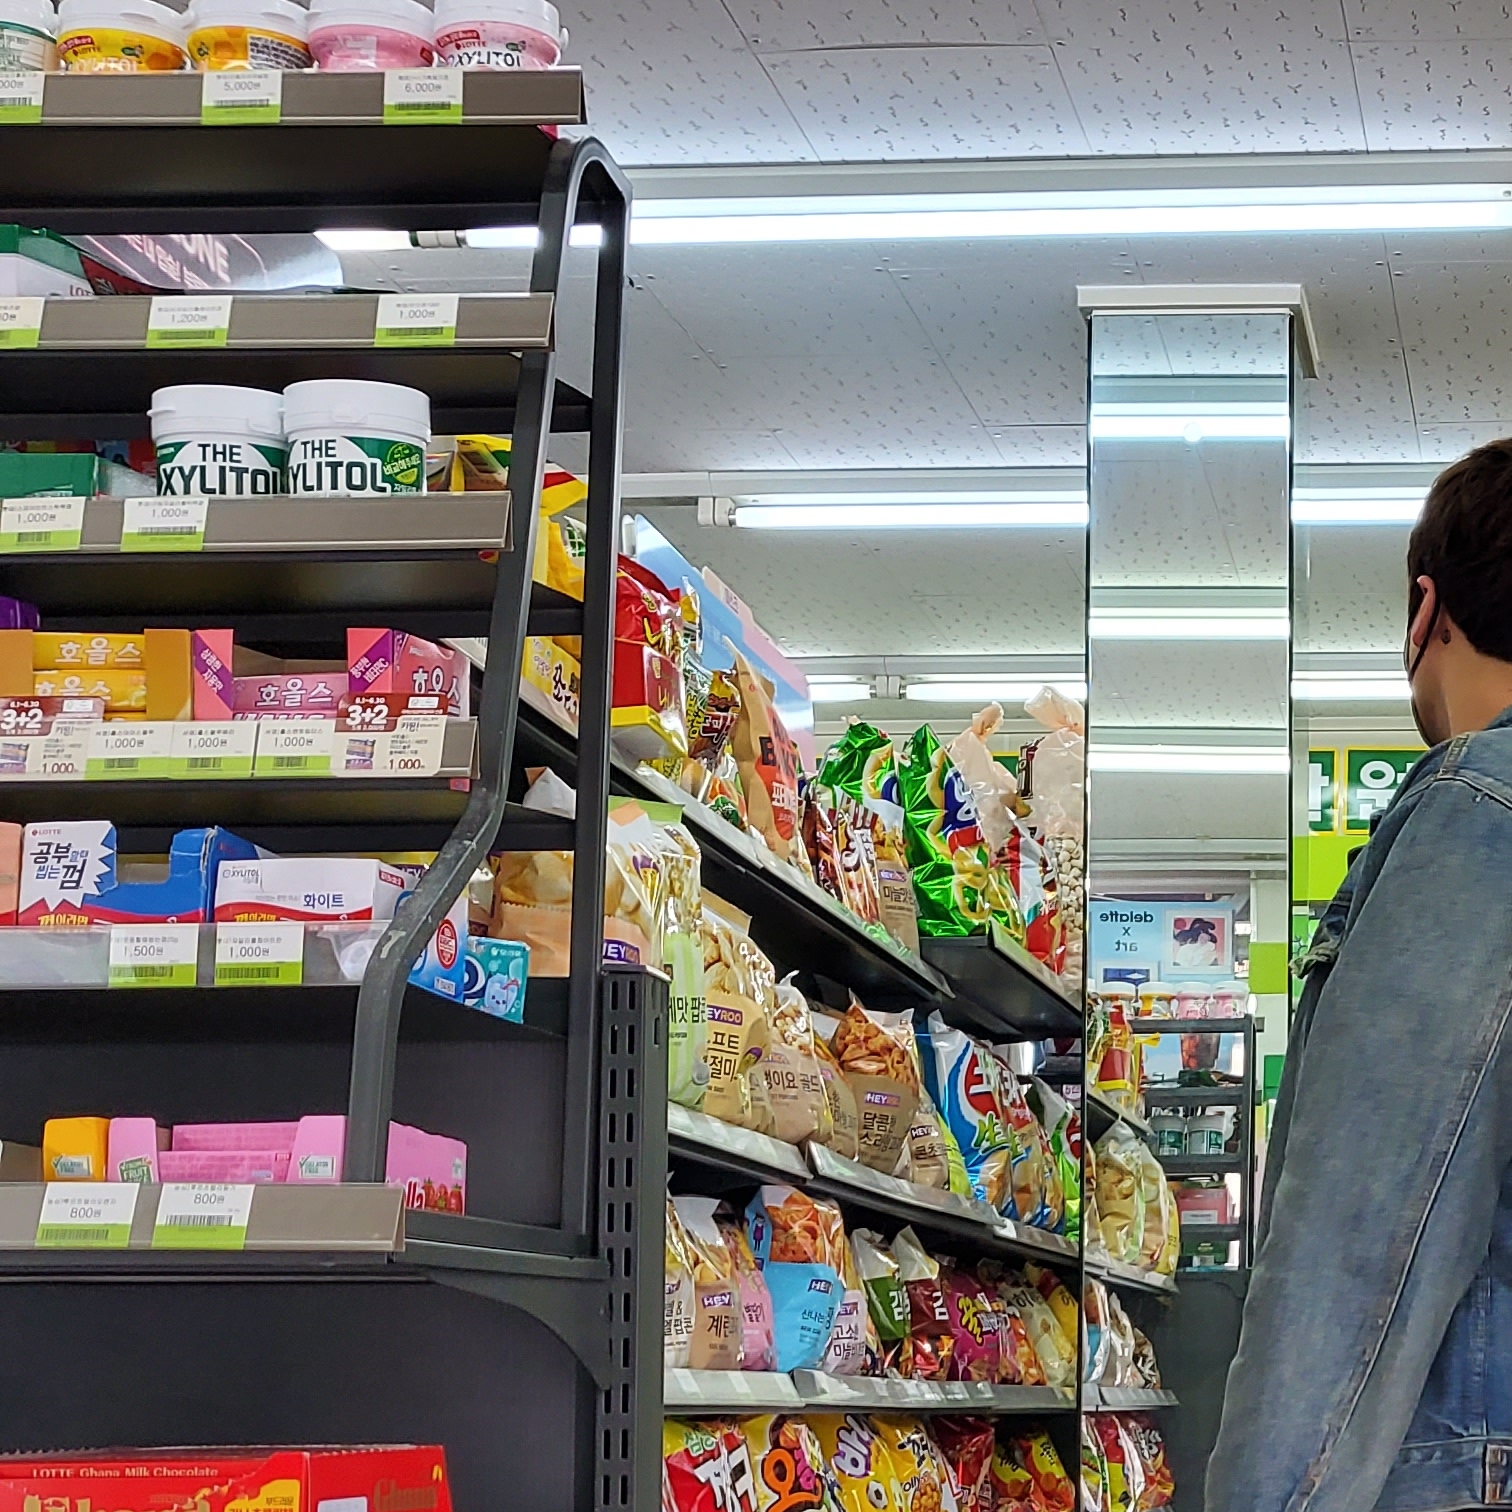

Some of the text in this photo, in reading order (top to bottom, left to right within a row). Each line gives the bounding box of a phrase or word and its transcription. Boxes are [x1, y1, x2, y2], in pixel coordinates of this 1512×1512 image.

[198, 443, 243, 463] THE
[301, 439, 337, 458] THE
[288, 461, 391, 494] YLITOL
[55, 637, 142, 665] 호올스
[256, 677, 333, 708] 호올스
[1, 708, 44, 731] 3+2
[347, 704, 389, 726] 3+2
[30, 842, 71, 864] 공부
[60, 861, 85, 890] 껌
[303, 892, 345, 909] 화이트
[706, 1005, 742, 1024] EYROO
[707, 1030, 739, 1050] 프트
[704, 1054, 738, 1082] 절미
